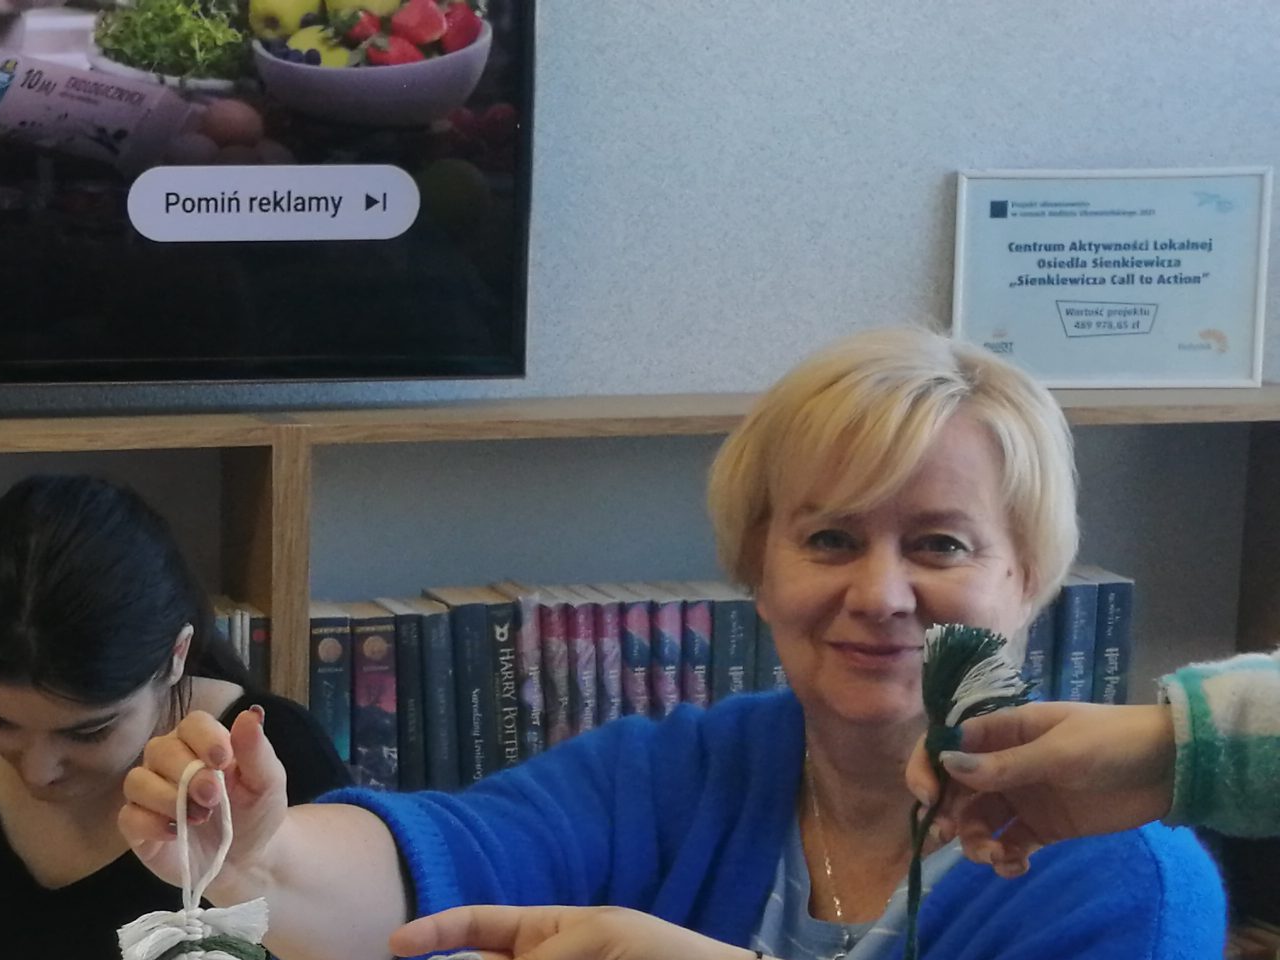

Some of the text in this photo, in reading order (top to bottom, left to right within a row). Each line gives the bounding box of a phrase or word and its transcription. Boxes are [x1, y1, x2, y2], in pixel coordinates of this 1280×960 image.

[165, 190, 343, 218] Pomiń reklamy
[1008, 237, 1213, 254] Centrum Aktywności Lokalnej
[1037, 256, 1181, 269] Osiedla Sienkiewicza
[1110, 273, 1135, 286] Call
[1139, 274, 1153, 285] to
[1065, 306, 1150, 320] Wartość projektu
[499, 648, 518, 701] HARRY
[1103, 646, 1121, 675] Harry
[1070, 650, 1087, 700] Harry Pot
[503, 706, 520, 764] POTTER
